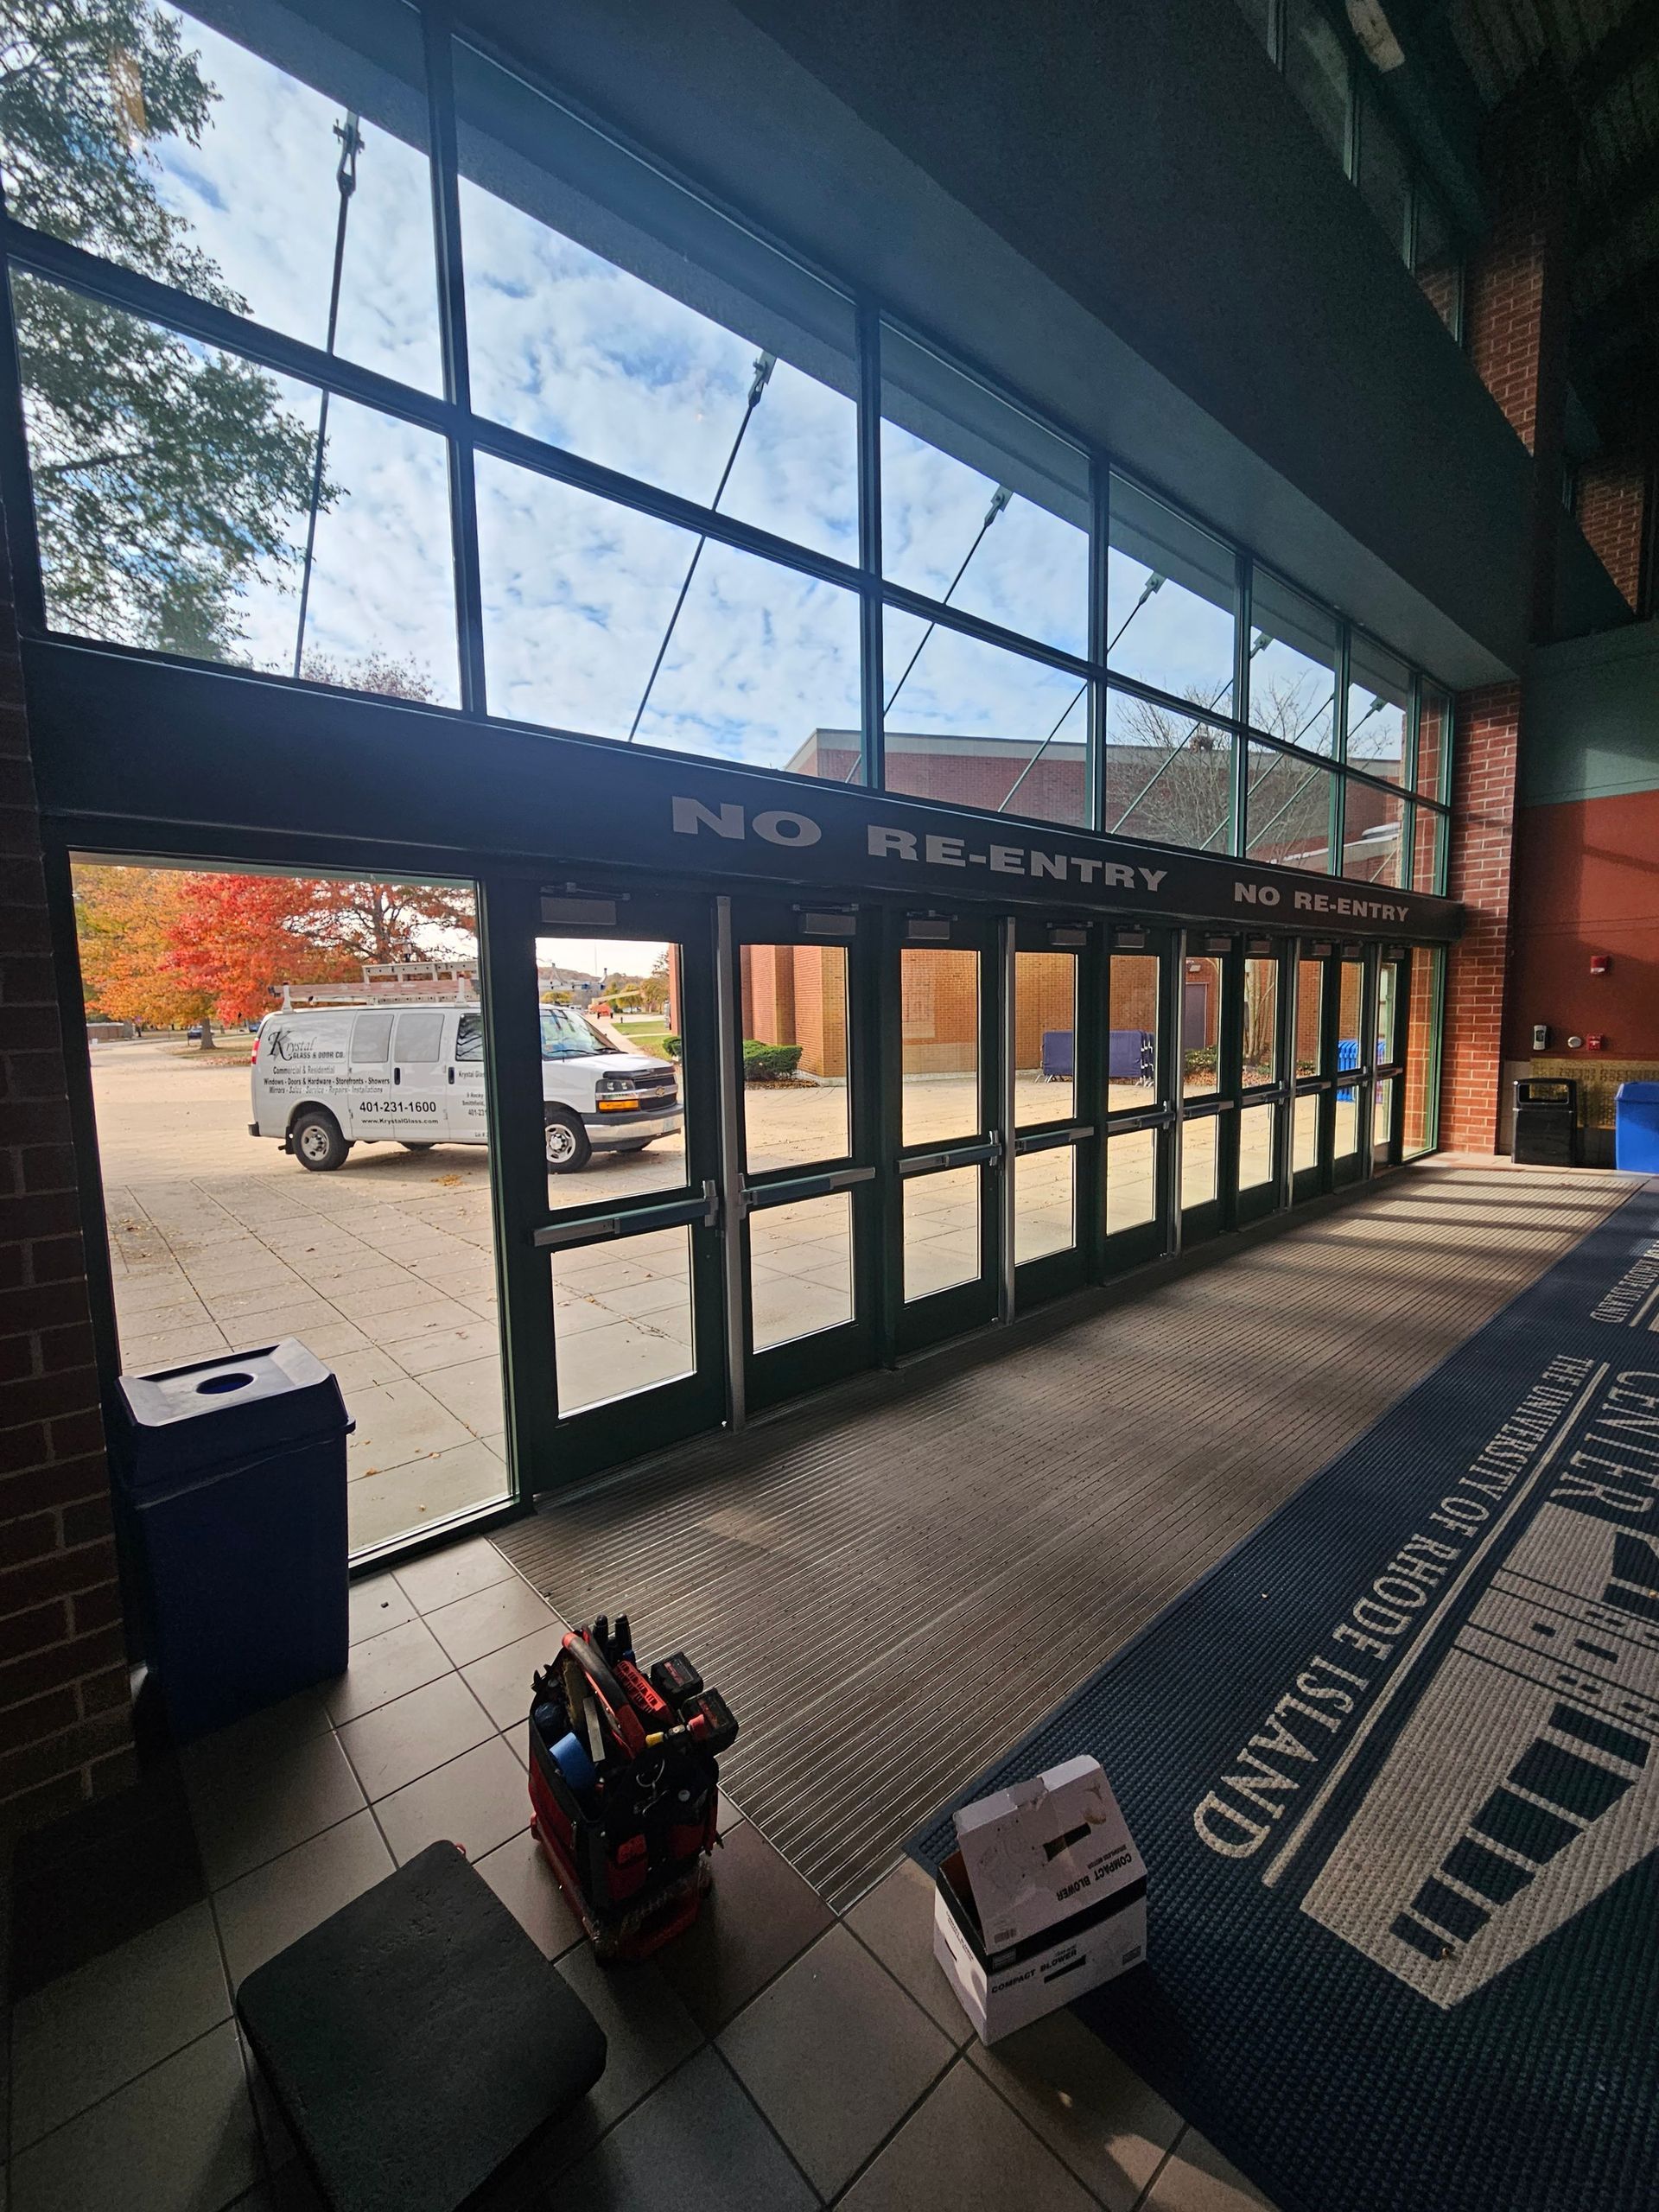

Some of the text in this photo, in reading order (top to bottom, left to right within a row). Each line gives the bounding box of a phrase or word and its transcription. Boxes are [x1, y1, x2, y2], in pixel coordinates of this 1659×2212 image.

[672, 796, 1168, 892] NO RE-ENTRY
[1234, 882, 1409, 922] NO RE-ENTRY
[268, 1030, 318, 1061] Krystal
[273, 1066, 302, 1075] Commercial
[308, 1065, 335, 1074] Residential
[458, 1071, 474, 1079] Krystal
[352, 1085, 383, 1094] Installations
[359, 1102, 436, 1113] 401-231-1600
[1589, 1285, 1645, 1323] ISLAND
[1192, 1353, 1595, 1859] THE UNIVERSITY OF RHODE ISLAND
[1094, 1852, 1132, 1881] COMPACT
[1056, 1875, 1091, 1902] BLOWER
[991, 1967, 1036, 1993] COMPACT
[1039, 1948, 1077, 1972] BLOWER
